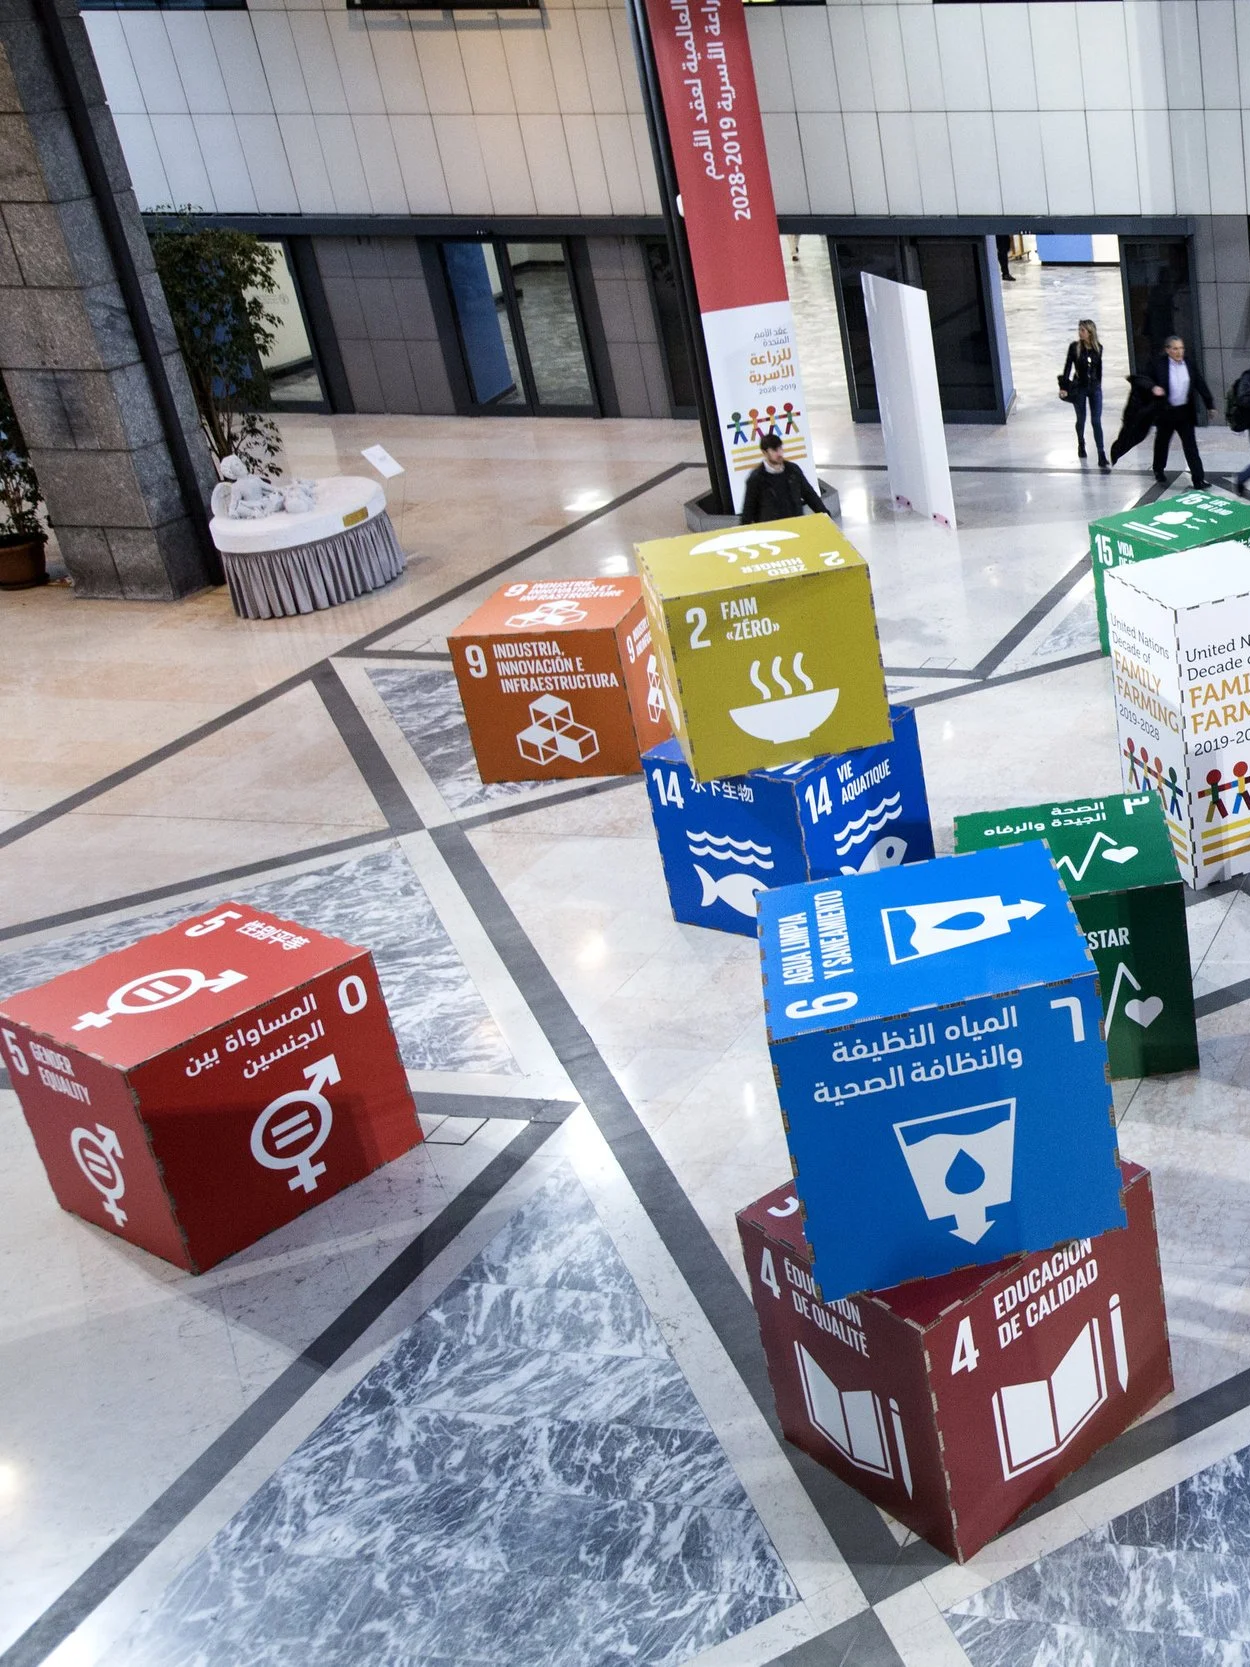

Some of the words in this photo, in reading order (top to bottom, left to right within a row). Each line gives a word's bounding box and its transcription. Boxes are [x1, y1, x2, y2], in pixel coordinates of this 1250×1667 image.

[706, 42, 737, 112] الأسرية
[684, 79, 708, 124] لعقد
[693, 130, 725, 180] الأمم
[750, 347, 792, 367] للزراعة
[749, 364, 795, 387] الأسرية
[741, 557, 804, 574] HUNGER
[819, 550, 846, 567] 2
[1094, 533, 1114, 567] 15
[1116, 540, 1135, 559] VIDA
[767, 564, 807, 577] ZERO
[504, 583, 529, 598] 9
[720, 597, 758, 619] FAIM
[686, 607, 711, 650] 2
[726, 618, 780, 641] «ZÉRO»
[1110, 612, 1137, 639] United
[1137, 627, 1170, 660] Nations
[466, 645, 487, 679] 9
[492, 640, 565, 660] INDUSTRIA,
[1111, 631, 1141, 658] Decade
[1142, 648, 1152, 665] of
[1185, 639, 1236, 664] United
[497, 656, 574, 677] INNOVACIÓN
[575, 656, 585, 672] E
[501, 671, 619, 694] INFRAESTRUCTURA
[1113, 648, 1162, 697] FAMILY
[1187, 655, 1245, 682] Decade
[1116, 673, 1180, 735] FARMING
[1118, 703, 1161, 741] 2019-2028
[837, 759, 854, 783] VIE
[841, 758, 892, 806] AQUATIQUE
[652, 768, 685, 810] 14
[804, 776, 833, 825] 14
[1050, 801, 1105, 817] الصحة
[1051, 812, 1107, 828] الجيدة
[983, 821, 1046, 837] والرفاه
[185, 910, 243, 937] 5
[235, 919, 312, 951] 性别平等
[778, 911, 812, 952] LIMPIA
[814, 889, 852, 968] SANEAMIENTO
[781, 949, 809, 986] AGUA
[824, 968, 854, 980] Y
[225, 993, 318, 1053] المساواة
[785, 991, 859, 1020] 6
[945, 1006, 1019, 1041] المياه
[1, 1027, 30, 1077] 5
[29, 1040, 76, 1078] GENDER
[242, 1020, 326, 1079] الجنسين
[831, 1022, 935, 1065] النظيفة
[184, 1046, 220, 1078] بين
[910, 1043, 1024, 1084] والنظافة
[39, 1066, 92, 1106] EQUALITY
[813, 1064, 905, 1107] الصحية
[759, 1247, 781, 1300] 4
[998, 1317, 1024, 1350] DE
[1025, 1258, 1099, 1338] CALIDAD
[792, 1289, 812, 1320] DE
[811, 1303, 870, 1359] QUALITÉ
[950, 1315, 980, 1376] 4
